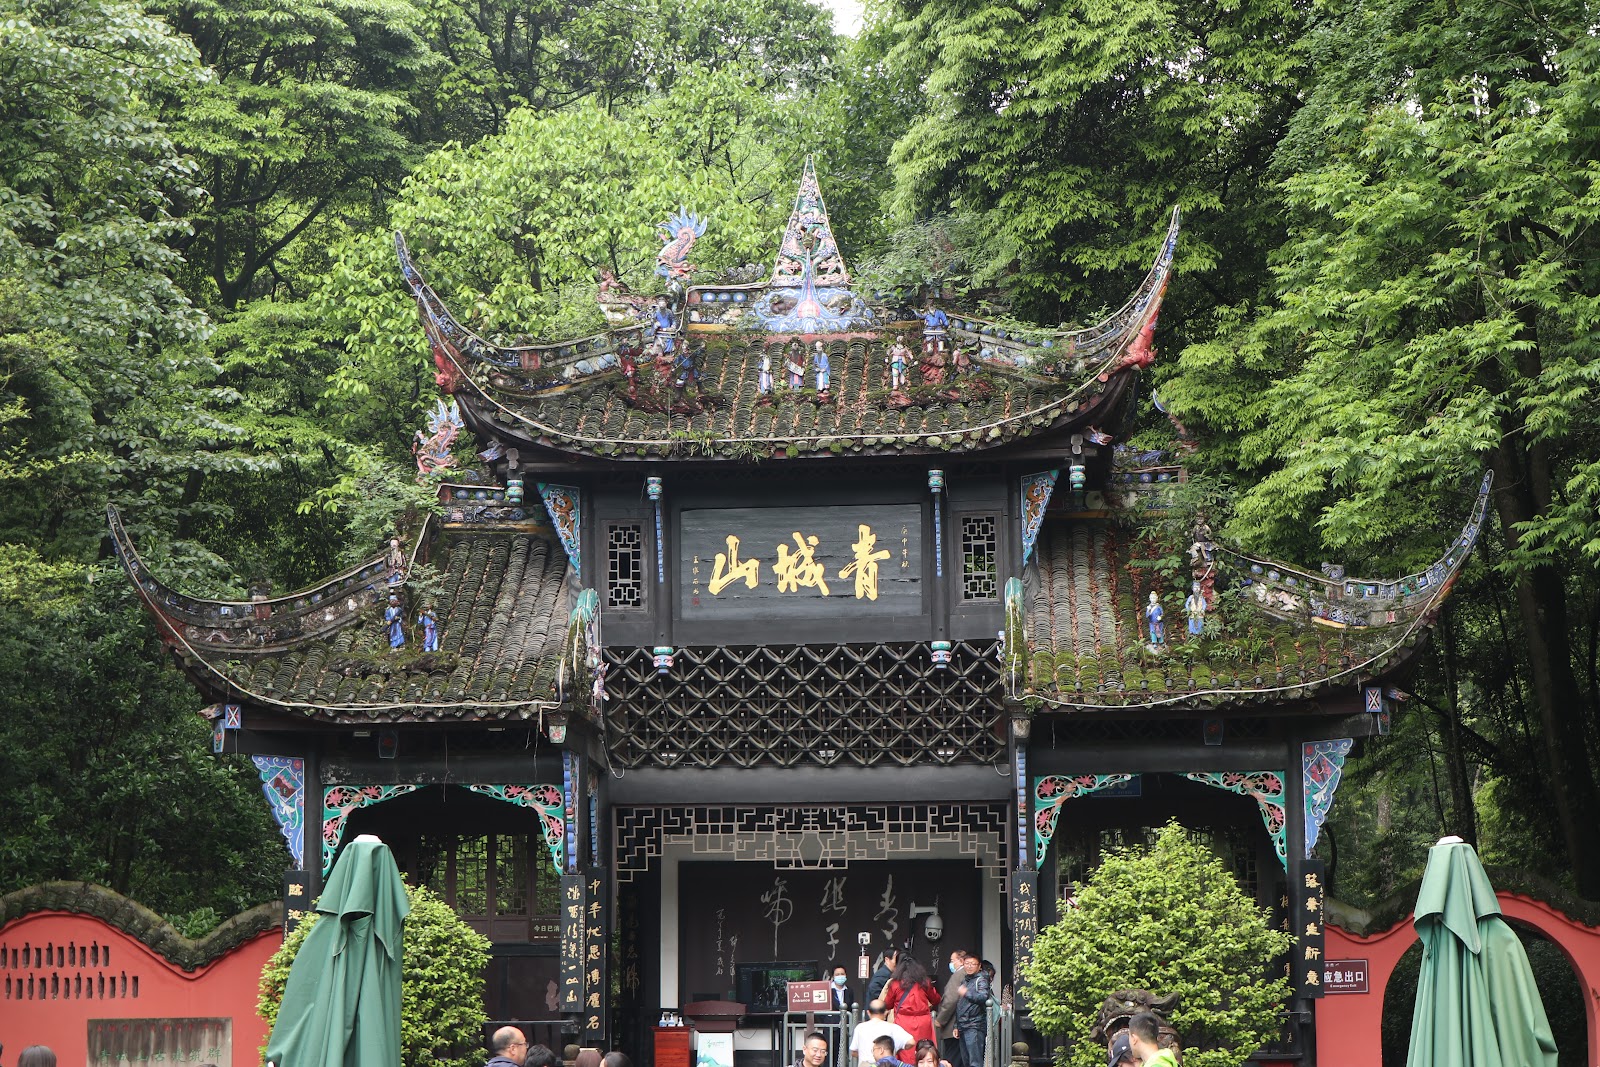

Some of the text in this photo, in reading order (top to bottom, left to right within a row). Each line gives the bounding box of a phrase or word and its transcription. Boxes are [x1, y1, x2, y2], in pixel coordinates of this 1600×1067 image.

[708, 524, 891, 601] 青城山
[1019, 882, 1032, 1001] 我爱阴符三
[1323, 971, 1364, 983] 应急出口
